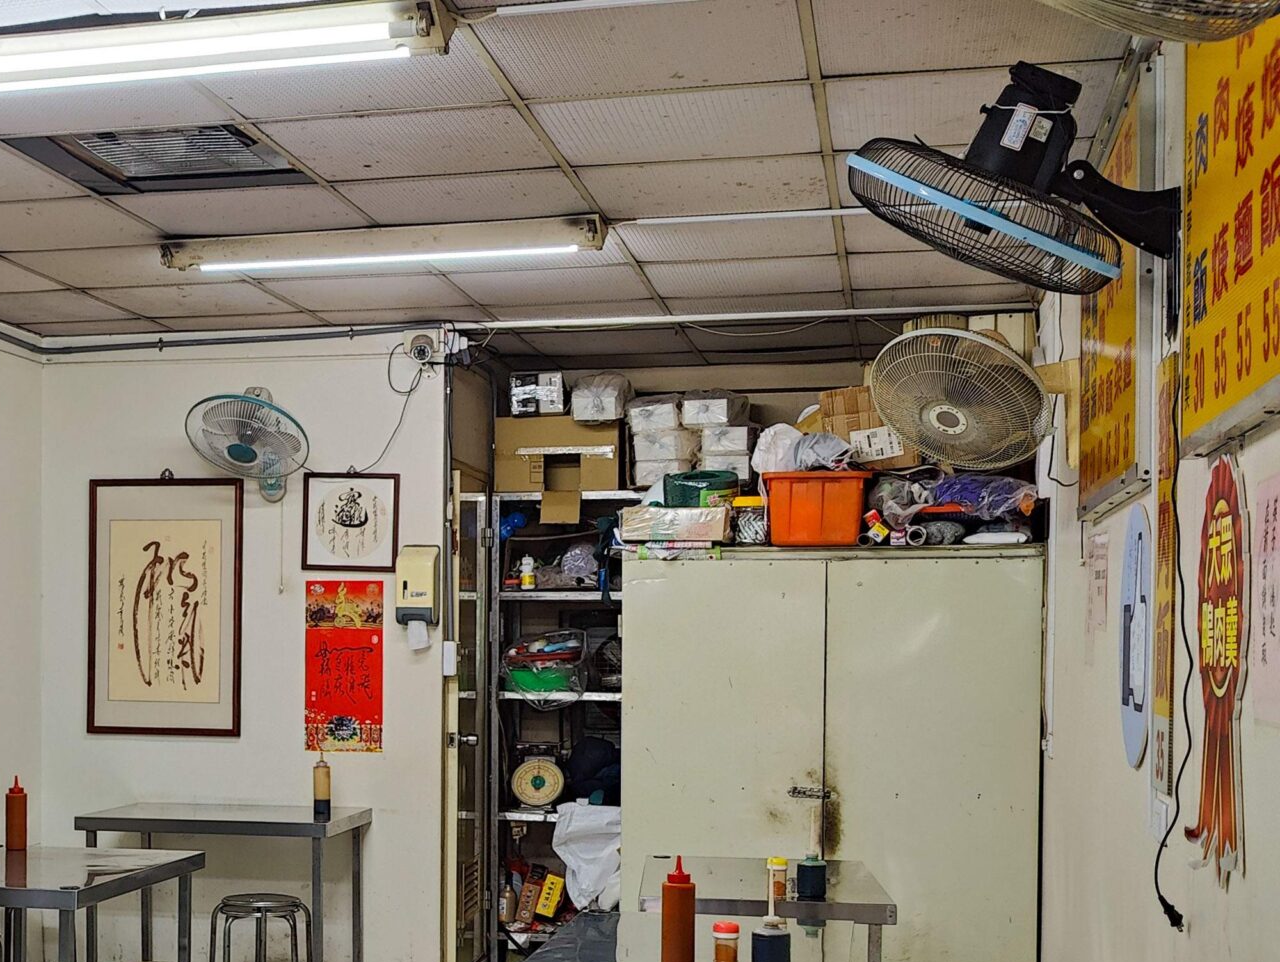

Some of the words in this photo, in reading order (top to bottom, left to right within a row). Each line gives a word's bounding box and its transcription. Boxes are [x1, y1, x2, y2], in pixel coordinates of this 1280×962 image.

[1214, 326, 1227, 400] 55
[1236, 303, 1252, 382] 55
[1193, 347, 1205, 414] 30
